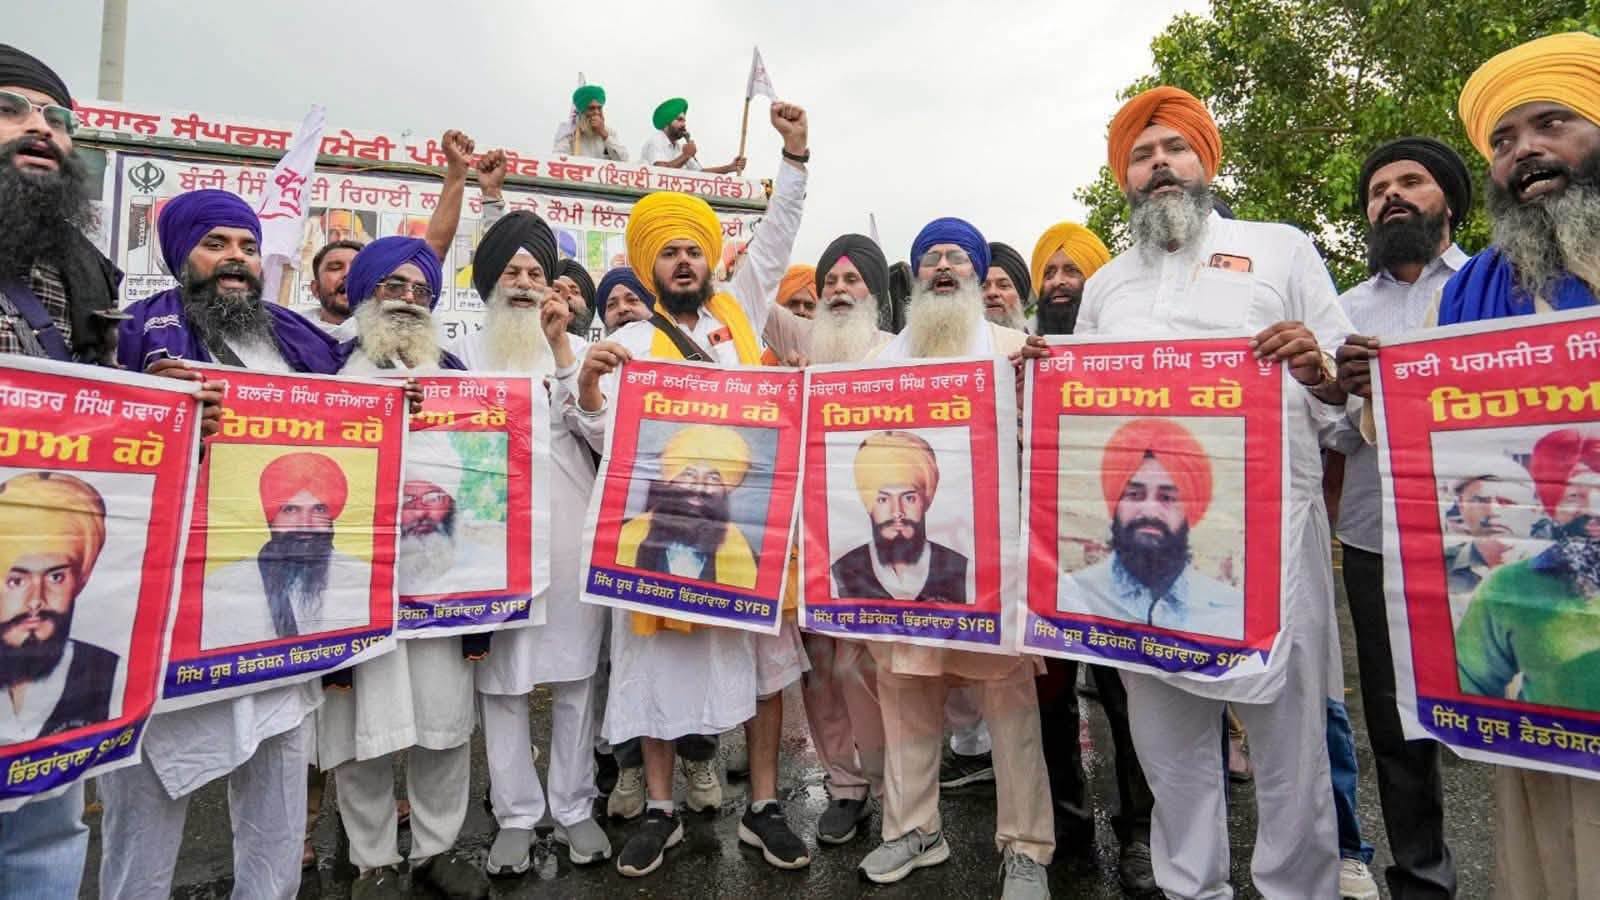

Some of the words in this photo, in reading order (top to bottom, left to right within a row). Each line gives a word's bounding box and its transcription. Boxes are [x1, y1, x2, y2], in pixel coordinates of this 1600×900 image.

[1082, 354, 1145, 373] ਜਗਤਾਰ
[1152, 347, 1193, 370] ਸਿੰਘ
[1200, 350, 1248, 370] ਤਾਰਾ
[1393, 353, 1441, 379] ਭਾਈ
[1449, 341, 1555, 374] ਪਰਮਜੀਤ
[1566, 331, 1600, 361] ਸਿੰ
[458, 380, 488, 398] ਸਿੰਘ
[626, 369, 657, 386] ਭਾਈ
[725, 378, 752, 395] ਸਿੰਘ
[787, 379, 799, 402] ਨੂੰ
[851, 378, 895, 396] ਜਗਤਾਰ
[899, 373, 925, 391] ਸਿੰਘ
[931, 374, 969, 391] ਹਵਾਰਾ
[974, 368, 987, 393] ਨੂੰ
[1059, 381, 1171, 409] ਰਿਹਾਅ
[1188, 378, 1243, 409] ਕਰੋ
[74, 389, 115, 417] ਸਿੰਘ
[121, 401, 171, 422] ਹਵਾਰਾ
[173, 403, 187, 432] ਨੂੰ
[291, 385, 320, 405] ਸਿੰਘ
[384, 392, 395, 416] ਨੂੰ
[643, 391, 728, 420] ਰਿਹਾਅ
[742, 400, 780, 422] ਕਰੋ
[821, 402, 915, 427] ਰਿਹਾਅ
[928, 395, 973, 421] ਕਰੋ
[342, 416, 384, 443] ਕਰੋ
[112, 431, 165, 465] ਕਰੋ
[491, 600, 527, 615] SYFB
[595, 571, 614, 588] ਸਿੱਖ
[734, 601, 771, 617] SYFB
[814, 609, 833, 624] ਸਿੱਖ
[958, 617, 996, 634] SYFB
[1034, 619, 1057, 637] ਸਿੱਖ
[1063, 628, 1083, 647] ਯੂਥ
[176, 665, 204, 684] ਸਿੱਖ
[210, 663, 232, 684] ਯੂਥ
[1432, 705, 1468, 732] ਸਿੱਖ
[1477, 717, 1510, 744] ਯੂਥ
[8, 746, 94, 785] ਭਿੰਡਰਾਂਵਾਲਾ
